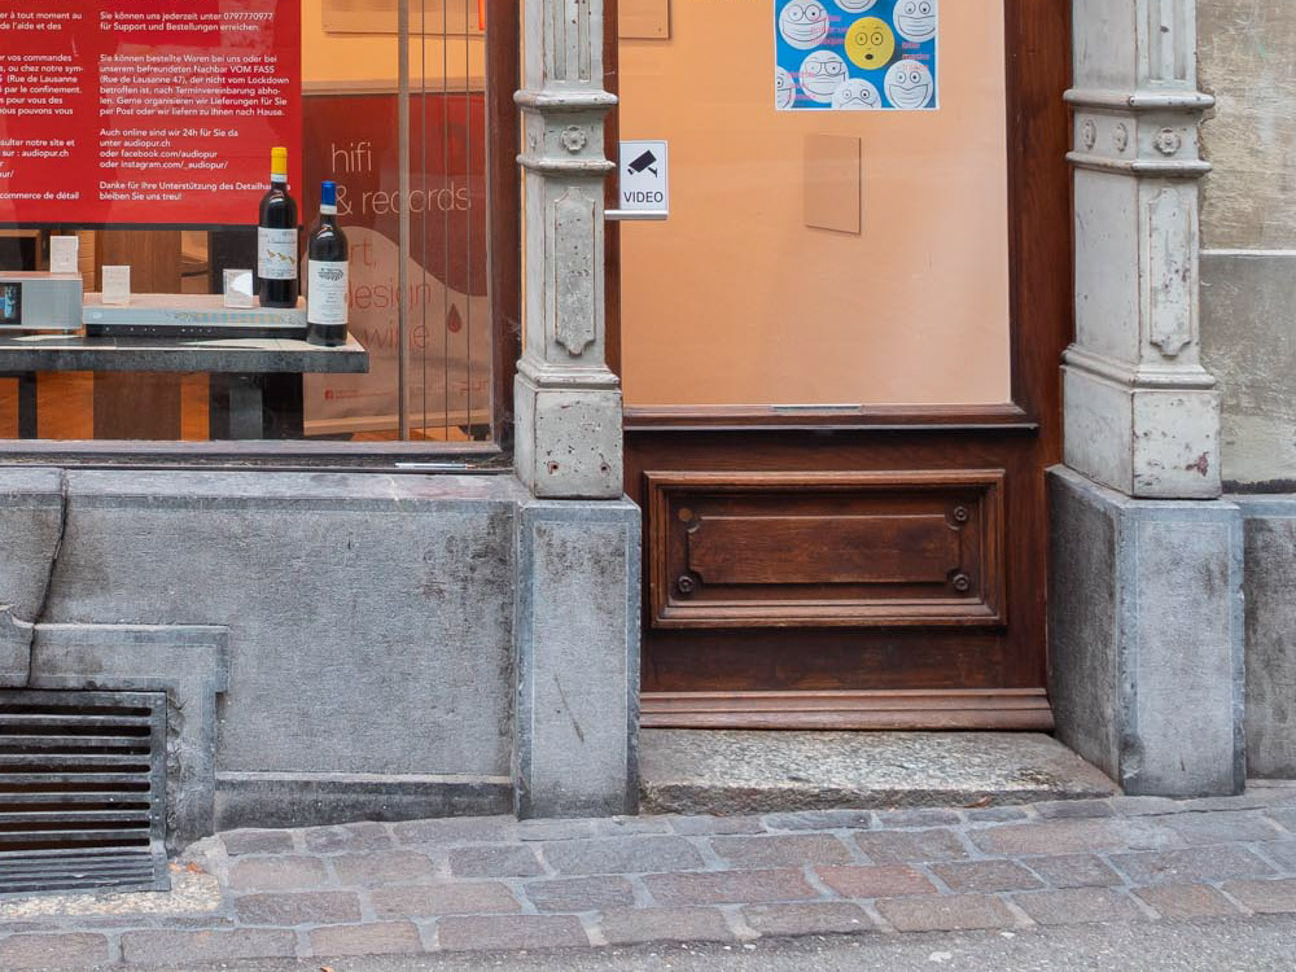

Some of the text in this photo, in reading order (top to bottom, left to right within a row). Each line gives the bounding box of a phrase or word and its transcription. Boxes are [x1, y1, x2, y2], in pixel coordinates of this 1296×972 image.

[17, 11, 34, 19] tout
[36, 11, 70, 19] moment
[100, 11, 112, 20] Sie
[114, 11, 144, 20] können
[162, 11, 198, 22] jederzeit
[200, 11, 222, 20] unter
[223, 12, 274, 20] 0797770977
[6, 97, 25, 106] pour
[48, 95, 64, 103] des
[17, 108, 52, 117] pouvons
[100, 128, 121, 136] Auch
[122, 128, 147, 136] online
[149, 128, 166, 136] sind
[168, 128, 180, 136] wir
[182, 128, 198, 136] 24h
[200, 128, 211, 136] für
[213, 128, 226, 137] Sie
[25, 138, 48, 146] notre
[49, 138, 64, 146] site
[100, 138, 172, 149] unter audiopur.ch
[21, 148, 70, 159] audiopur.ch
[100, 149, 218, 160] oder facebook.com/audiopur
[331, 142, 372, 173] hifi
[100, 160, 119, 168] oder
[100, 181, 126, 189] Danke
[127, 181, 139, 189] für
[158, 181, 217, 191] Unterstützung
[219, 181, 234, 189] des
[235, 181, 290, 190] Detailhas
[56, 191, 80, 199] détail
[100, 191, 130, 200] bleiben
[132, 191, 144, 200] Sie
[162, 191, 182, 200] treu!
[336, 182, 472, 216] & records
[624, 191, 664, 203] VIDEO
[349, 236, 377, 268] rt,
